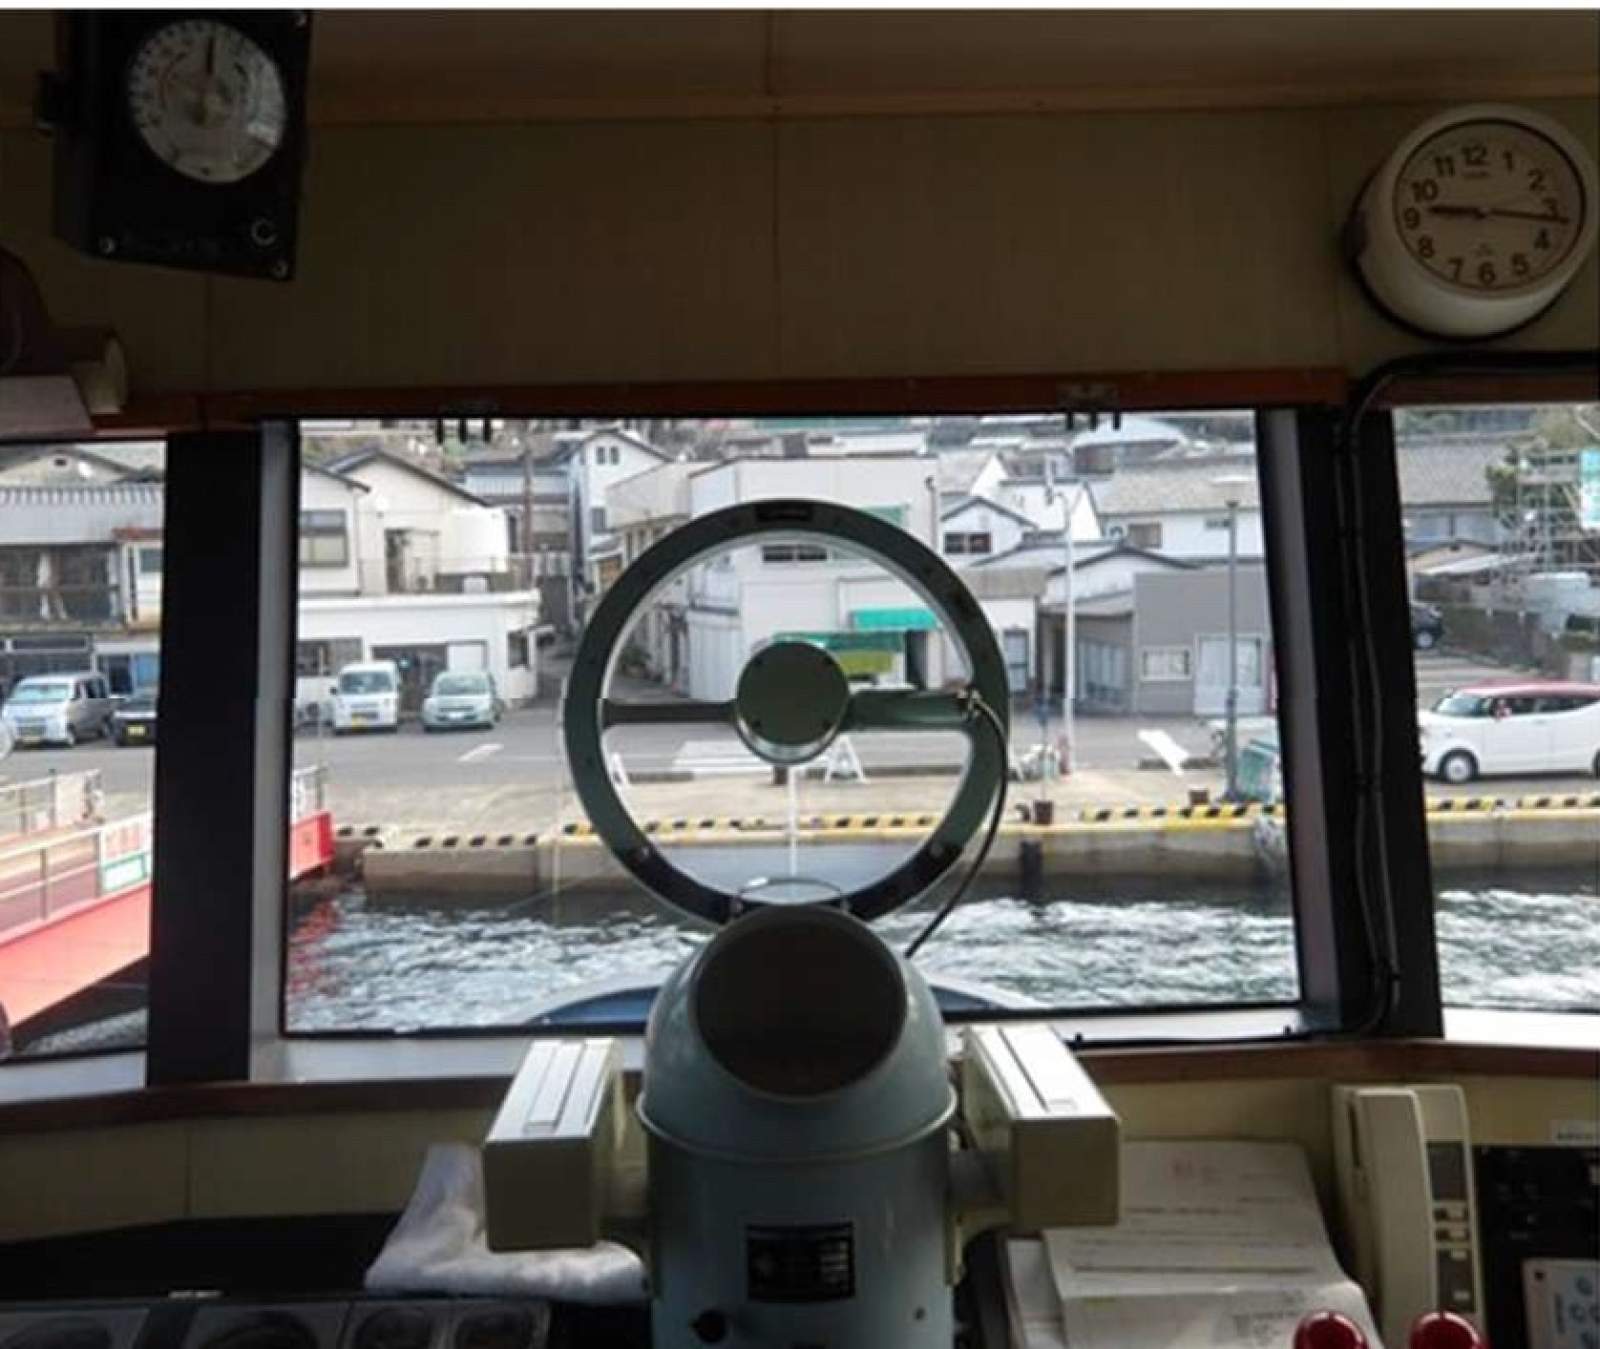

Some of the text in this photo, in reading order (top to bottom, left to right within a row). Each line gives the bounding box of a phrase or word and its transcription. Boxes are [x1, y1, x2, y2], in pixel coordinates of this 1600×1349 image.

[1462, 144, 1488, 166] 12
[1502, 150, 1514, 171] 1
[1434, 156, 1455, 177] 11
[1411, 179, 1438, 202] 10
[1528, 168, 1546, 192] 2
[1404, 207, 1420, 230] 9
[1541, 198, 1559, 220] 3
[1418, 237, 1434, 258] 8
[1533, 228, 1550, 250] 4
[1448, 258, 1464, 282] 7
[1479, 262, 1495, 286] 6
[1511, 253, 1529, 275] 5
